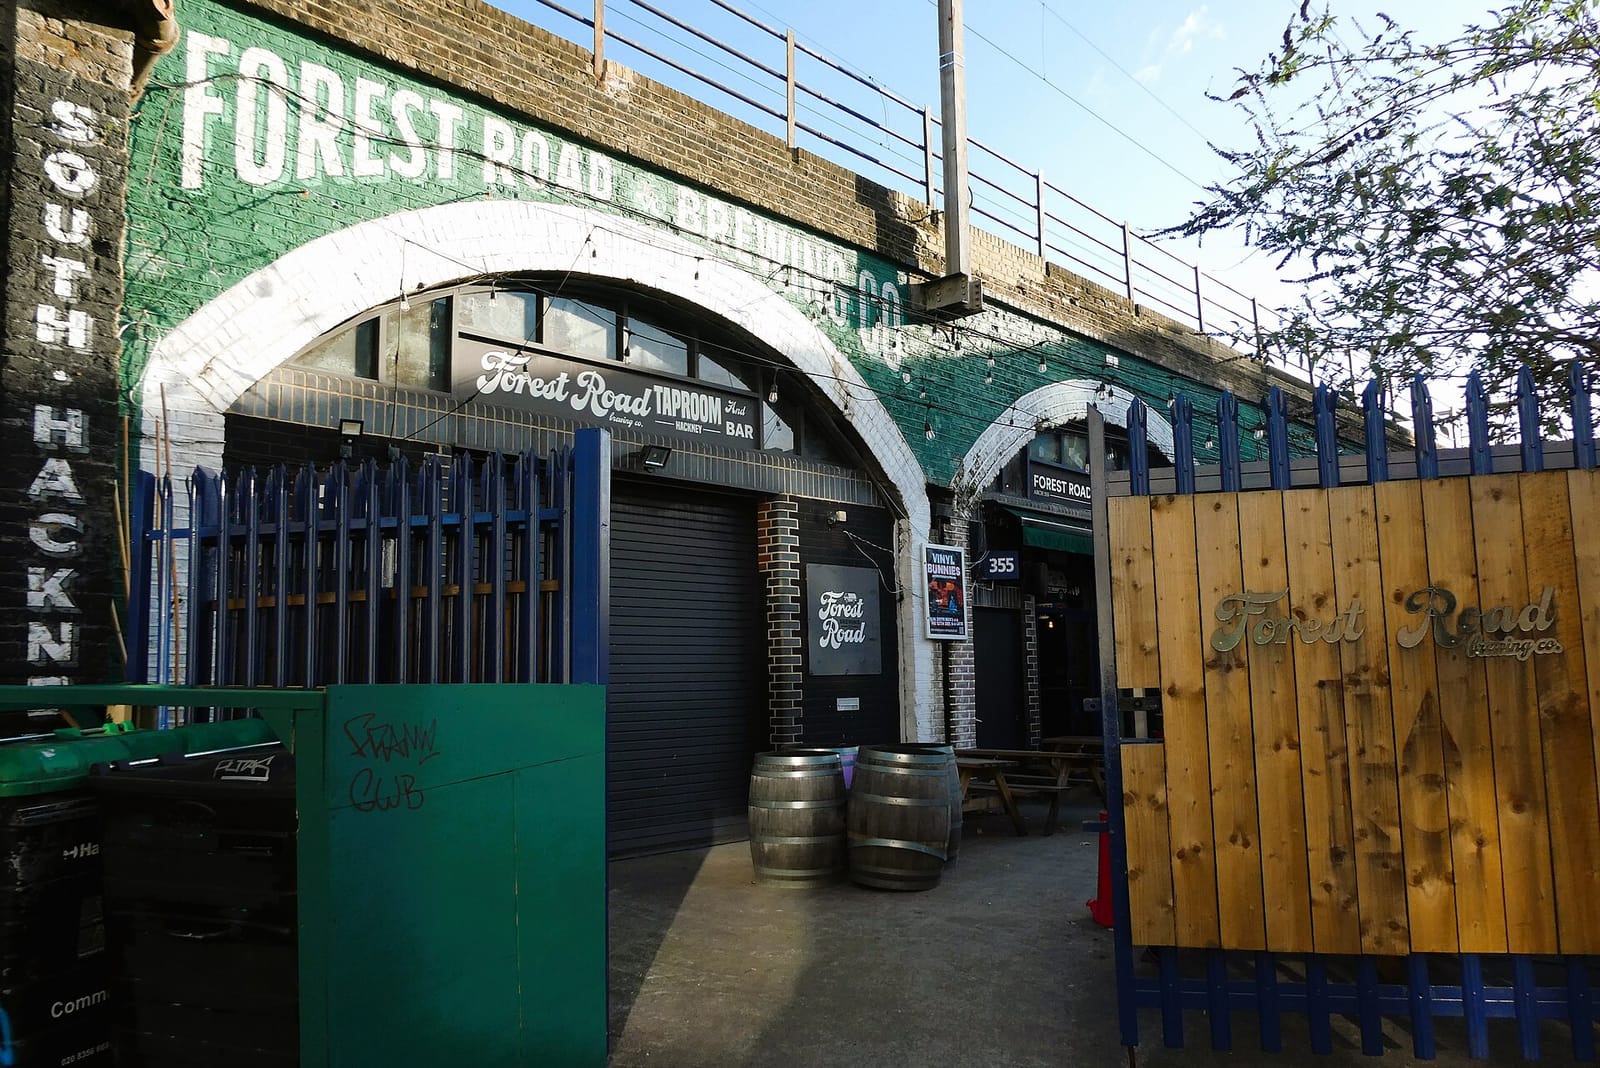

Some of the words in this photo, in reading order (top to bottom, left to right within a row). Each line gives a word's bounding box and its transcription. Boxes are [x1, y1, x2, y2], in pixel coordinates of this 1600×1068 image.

[180, 30, 465, 190] FOREST
[483, 117, 613, 201] ROAD
[36, 99, 97, 350] SOUTH
[476, 350, 569, 402] Forest
[570, 370, 652, 417] Road
[653, 385, 722, 425] TAPROOM
[724, 400, 747, 417] And
[675, 420, 703, 434] HACKNEY
[725, 421, 754, 440] BAR
[1033, 474, 1067, 494] FOREST
[1068, 482, 1091, 499] ROAD
[26, 404, 85, 716] HACKN
[927, 563, 961, 576] BUNNIES
[932, 553, 956, 565] VINYL
[989, 558, 1014, 573] 355
[818, 591, 864, 620] Forest
[1210, 587, 1366, 652] Forest
[1396, 584, 1557, 649] Road
[819, 617, 866, 649] Road
